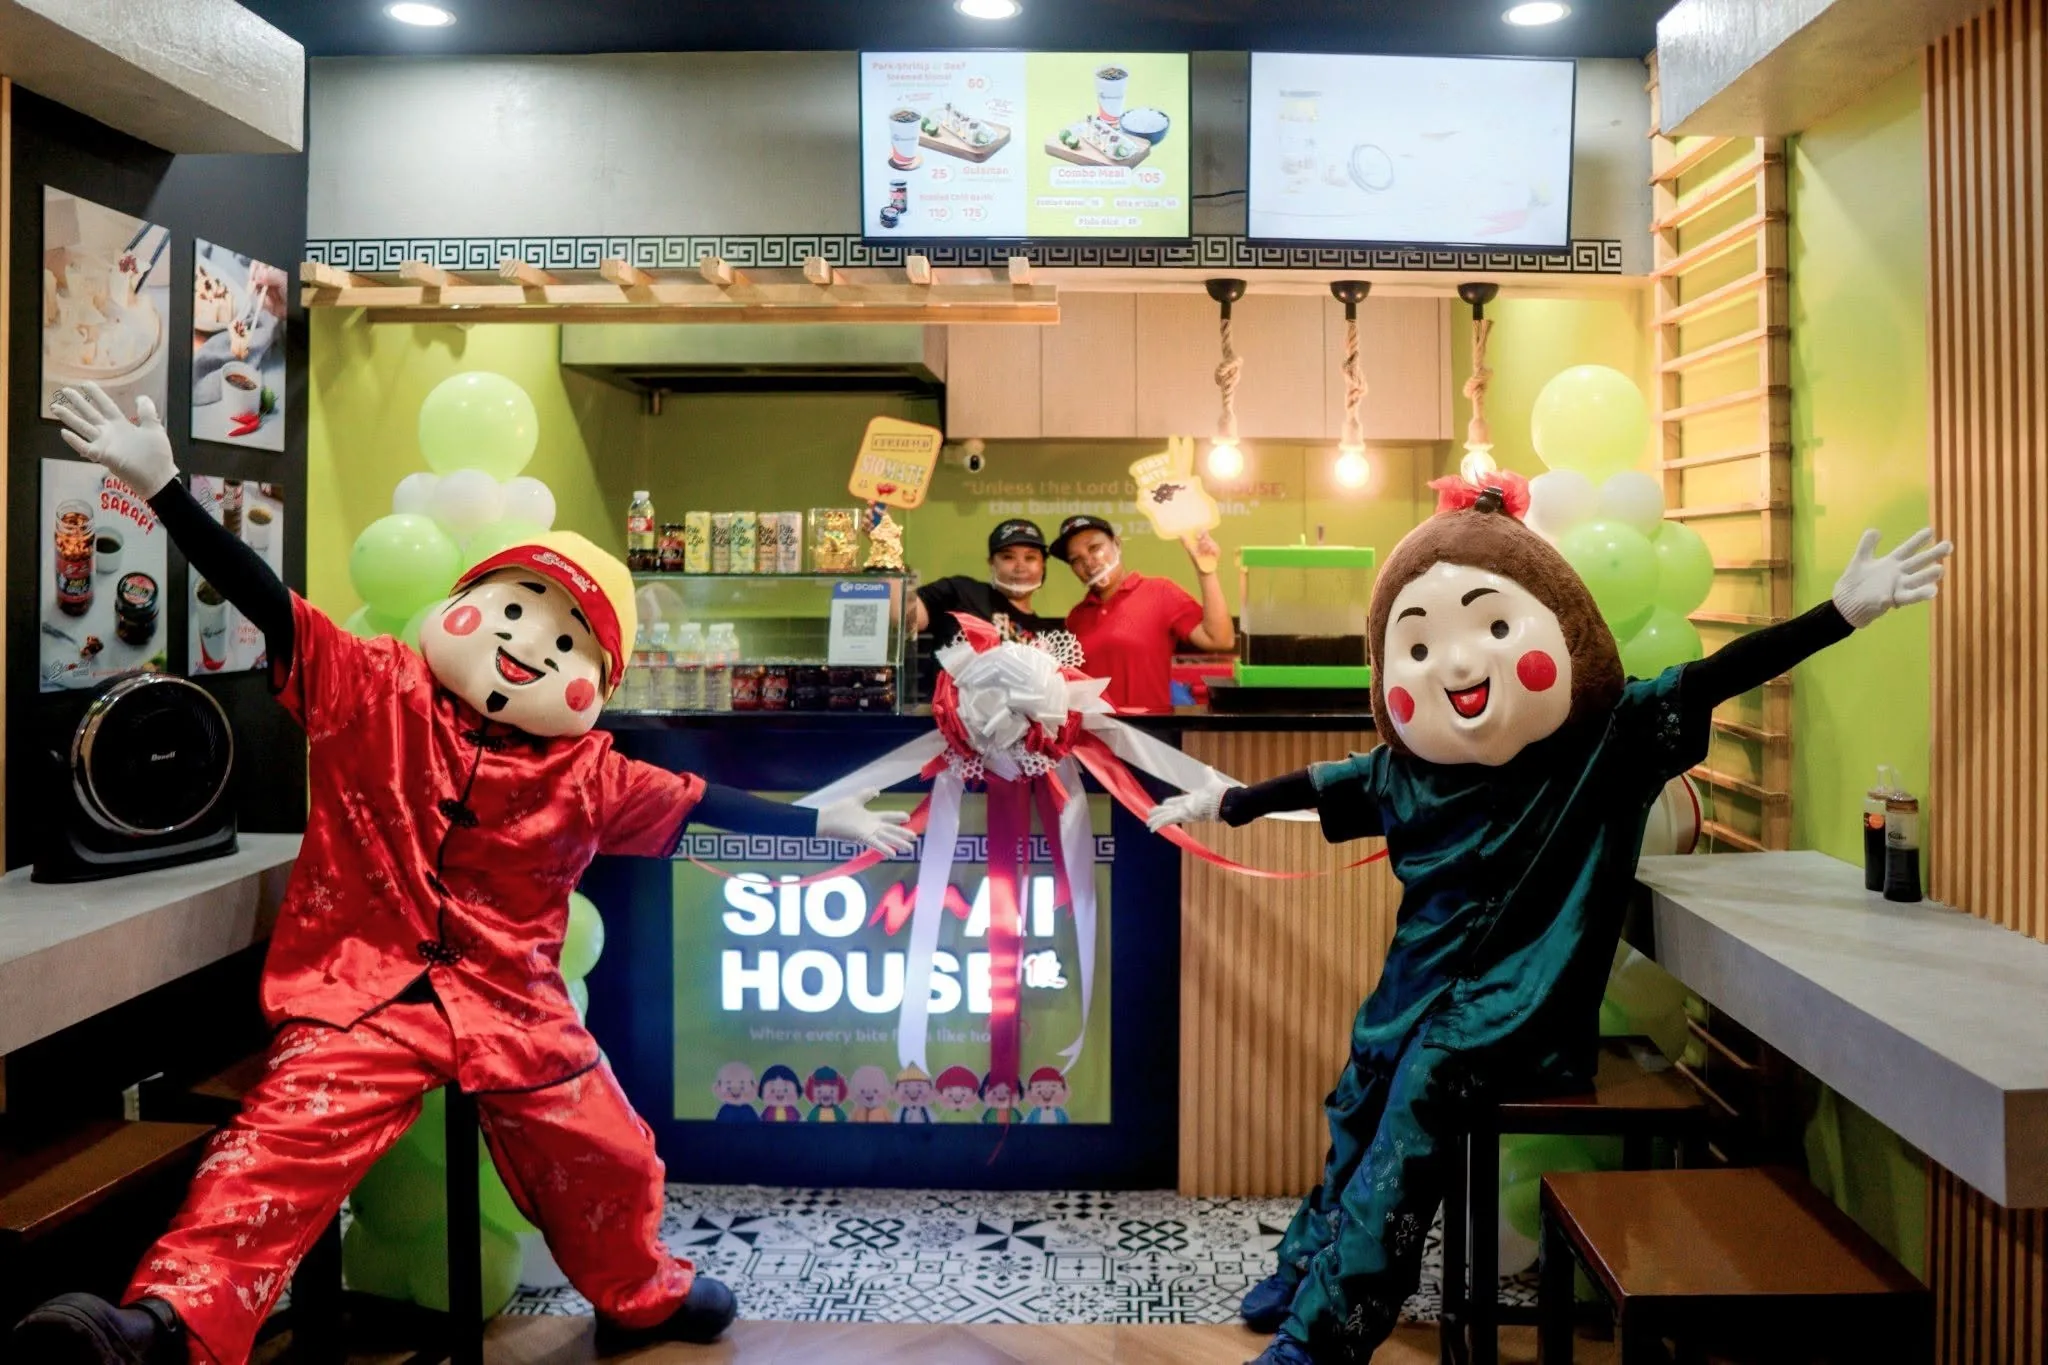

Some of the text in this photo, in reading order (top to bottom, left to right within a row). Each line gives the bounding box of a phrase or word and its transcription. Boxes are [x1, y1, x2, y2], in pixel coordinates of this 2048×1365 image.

[931, 168, 948, 179] 25
[1058, 168, 1125, 178] Combo Meal
[1138, 172, 1161, 184] 105
[1040, 480, 1071, 495] the
[1076, 480, 1118, 495] Lord
[100, 492, 155, 535] SARAP!
[989, 499, 1023, 515] the
[1028, 498, 1113, 515] builders
[854, 583, 885, 592] GCash
[721, 949, 1018, 1014] HOUSE
[750, 1026, 800, 1042] Where
[806, 1028, 851, 1046] every
[856, 1027, 888, 1043] bite
[936, 1028, 967, 1043] like
